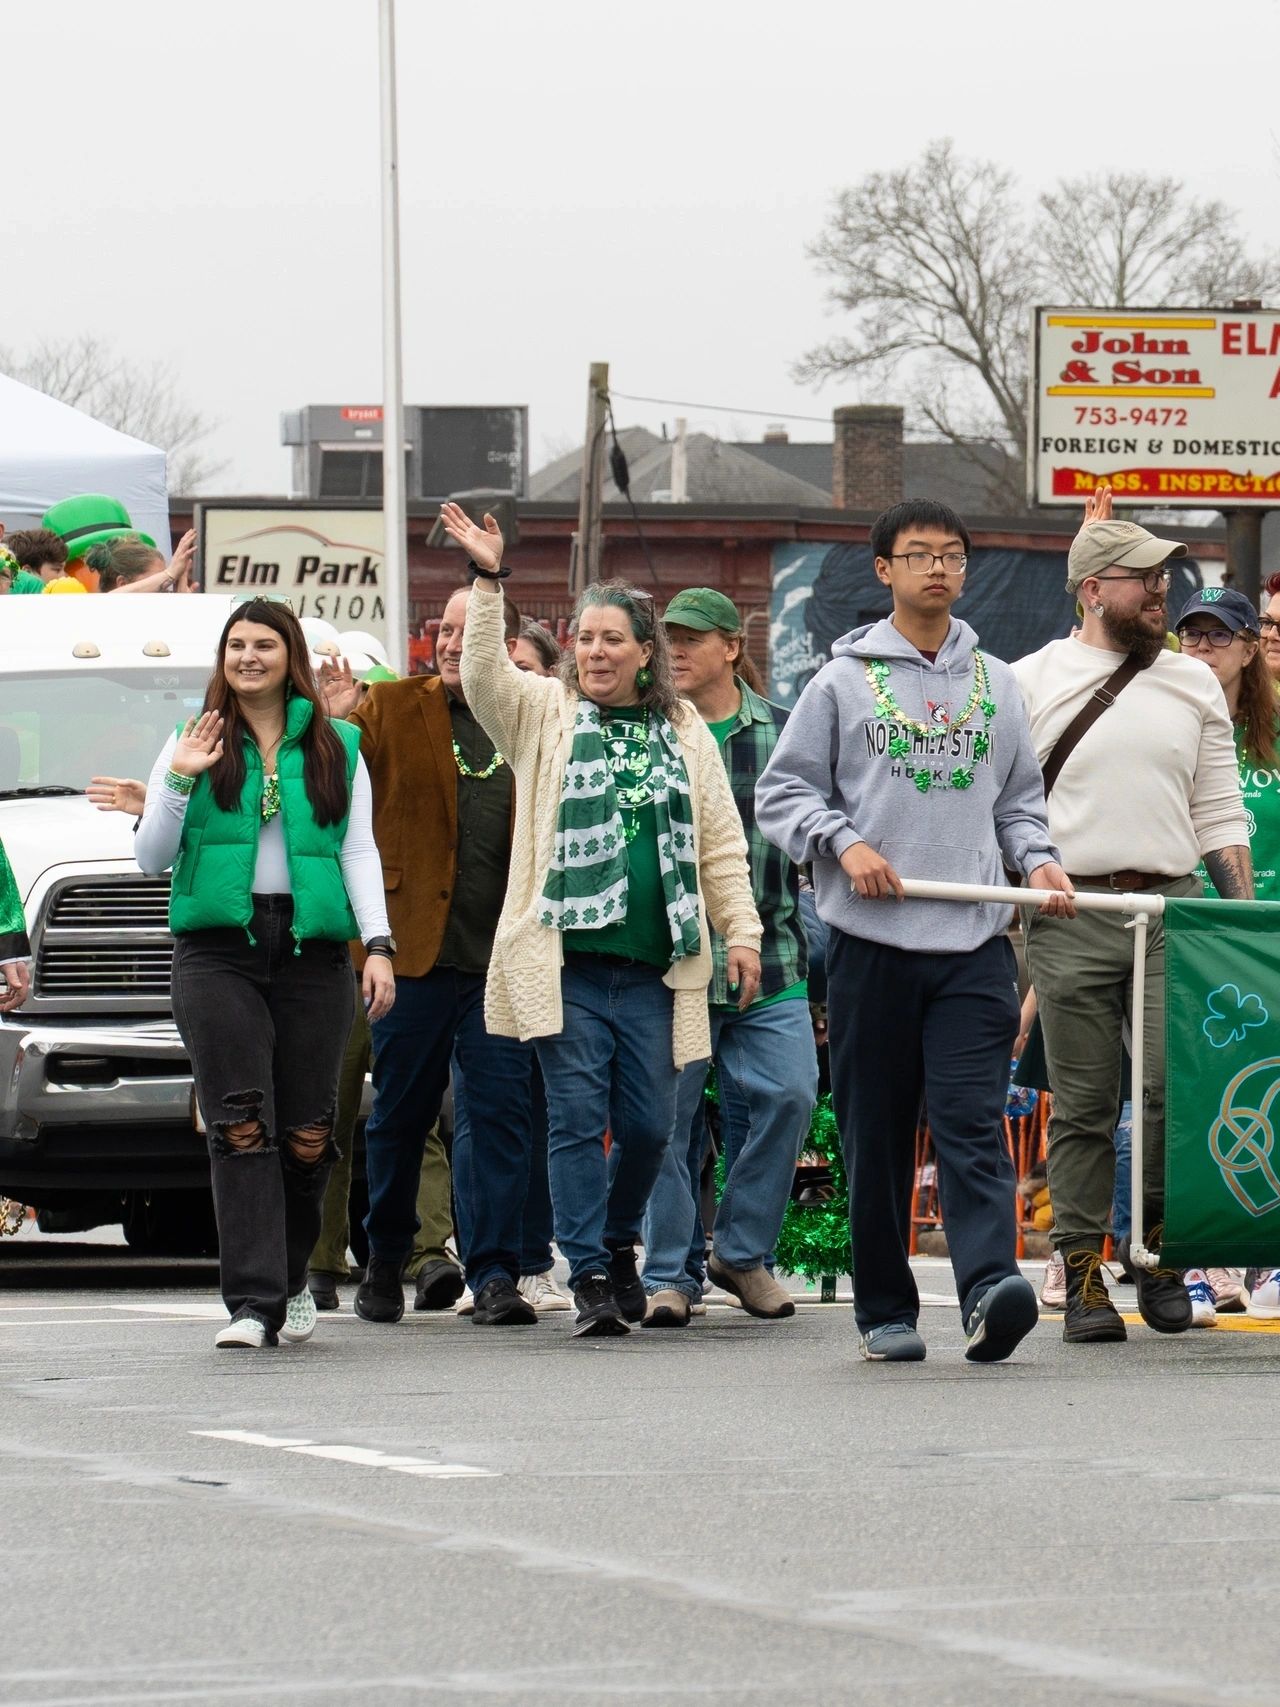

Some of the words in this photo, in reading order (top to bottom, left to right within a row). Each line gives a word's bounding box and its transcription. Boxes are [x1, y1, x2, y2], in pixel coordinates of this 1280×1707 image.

[1071, 331, 1191, 356] John
[1059, 359, 1101, 385] &
[1111, 360, 1203, 385] Son
[1073, 406, 1189, 428] 753-9472
[1041, 436, 1139, 456] FOREIGN
[1147, 439, 1164, 455] &
[1073, 472, 1150, 493] MASS.
[216, 555, 280, 586] Elm
[294, 555, 382, 587] Park
[298, 595, 386, 622] ISION
